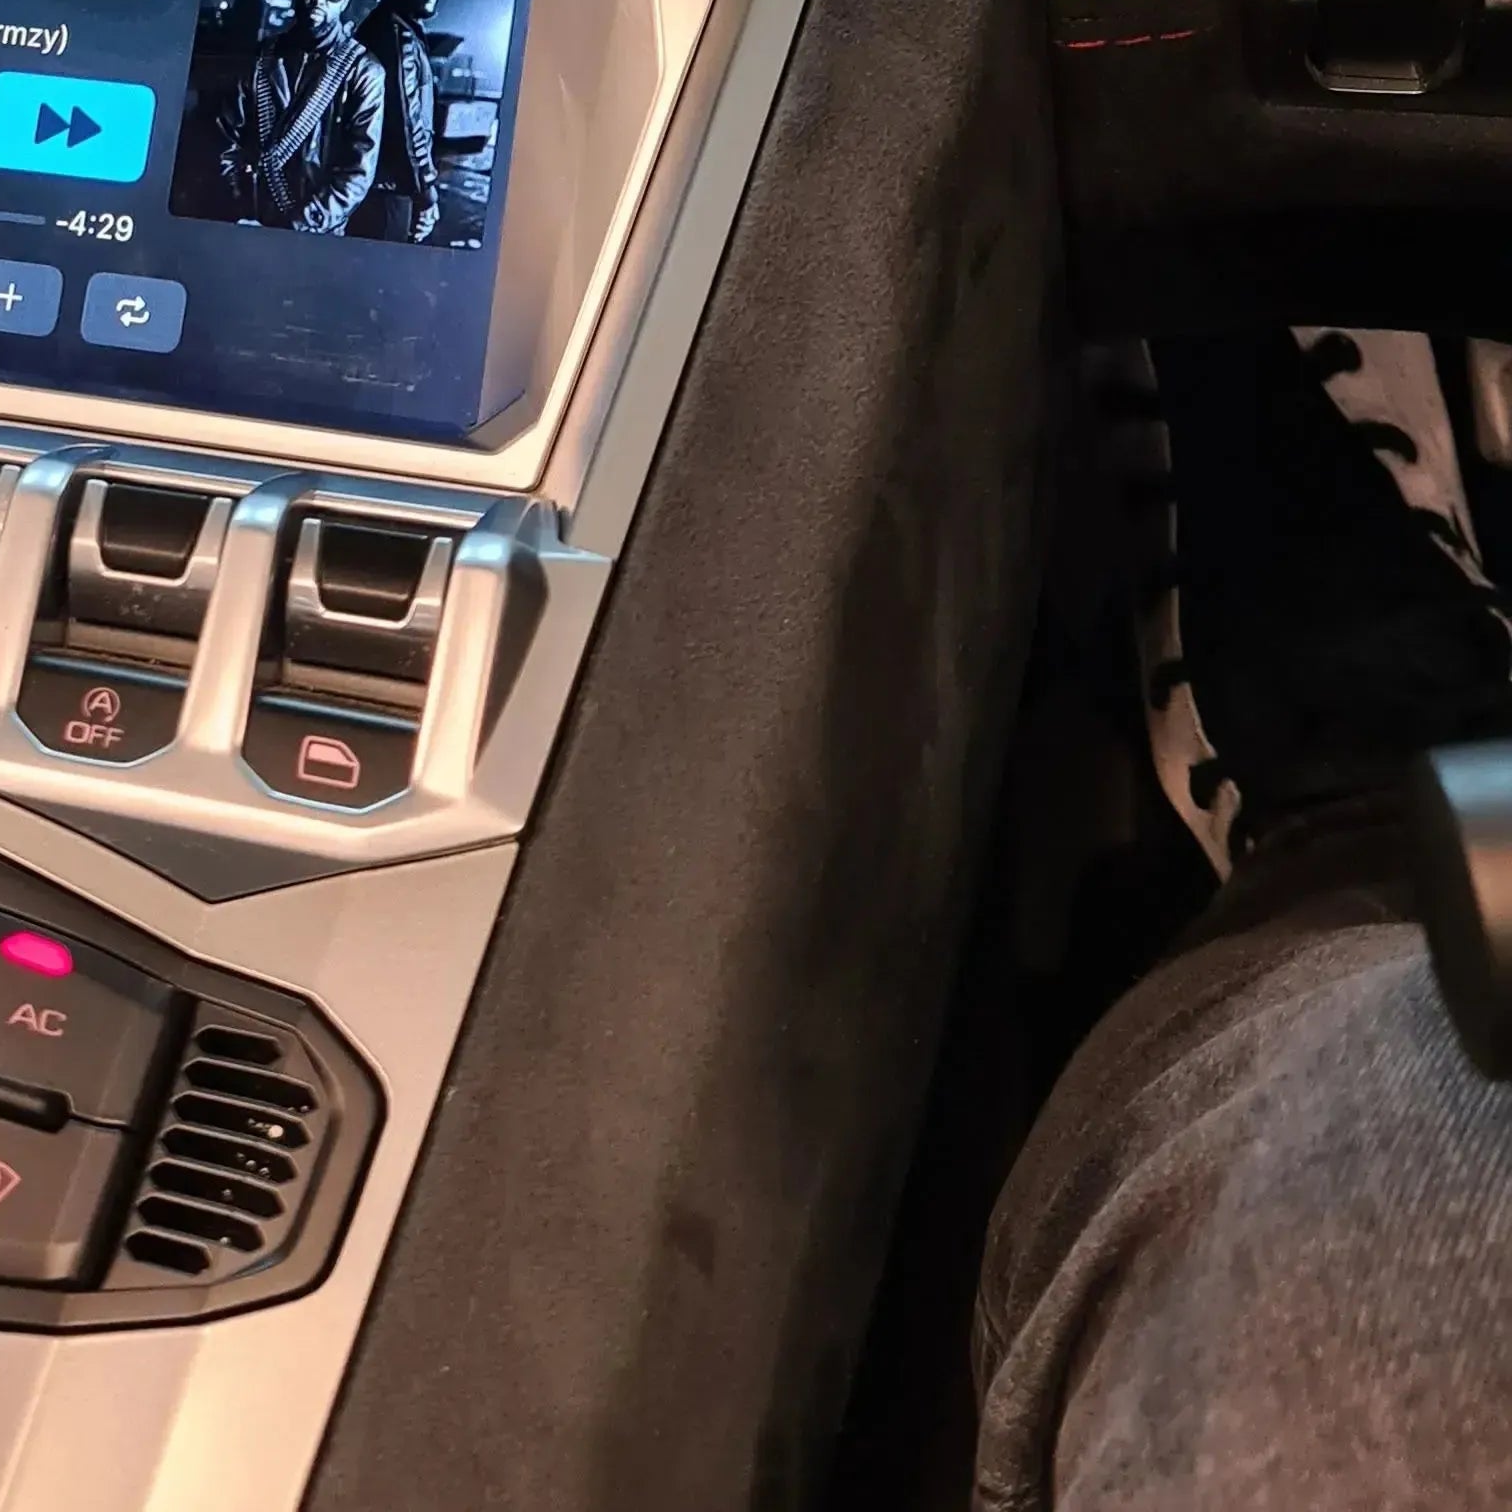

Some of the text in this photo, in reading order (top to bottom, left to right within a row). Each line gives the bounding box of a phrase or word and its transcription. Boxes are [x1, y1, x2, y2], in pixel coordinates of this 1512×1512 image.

[55, 209, 135, 244] -4:29
[64, 720, 125, 749] OFF
[5, 1003, 68, 1037] AC
